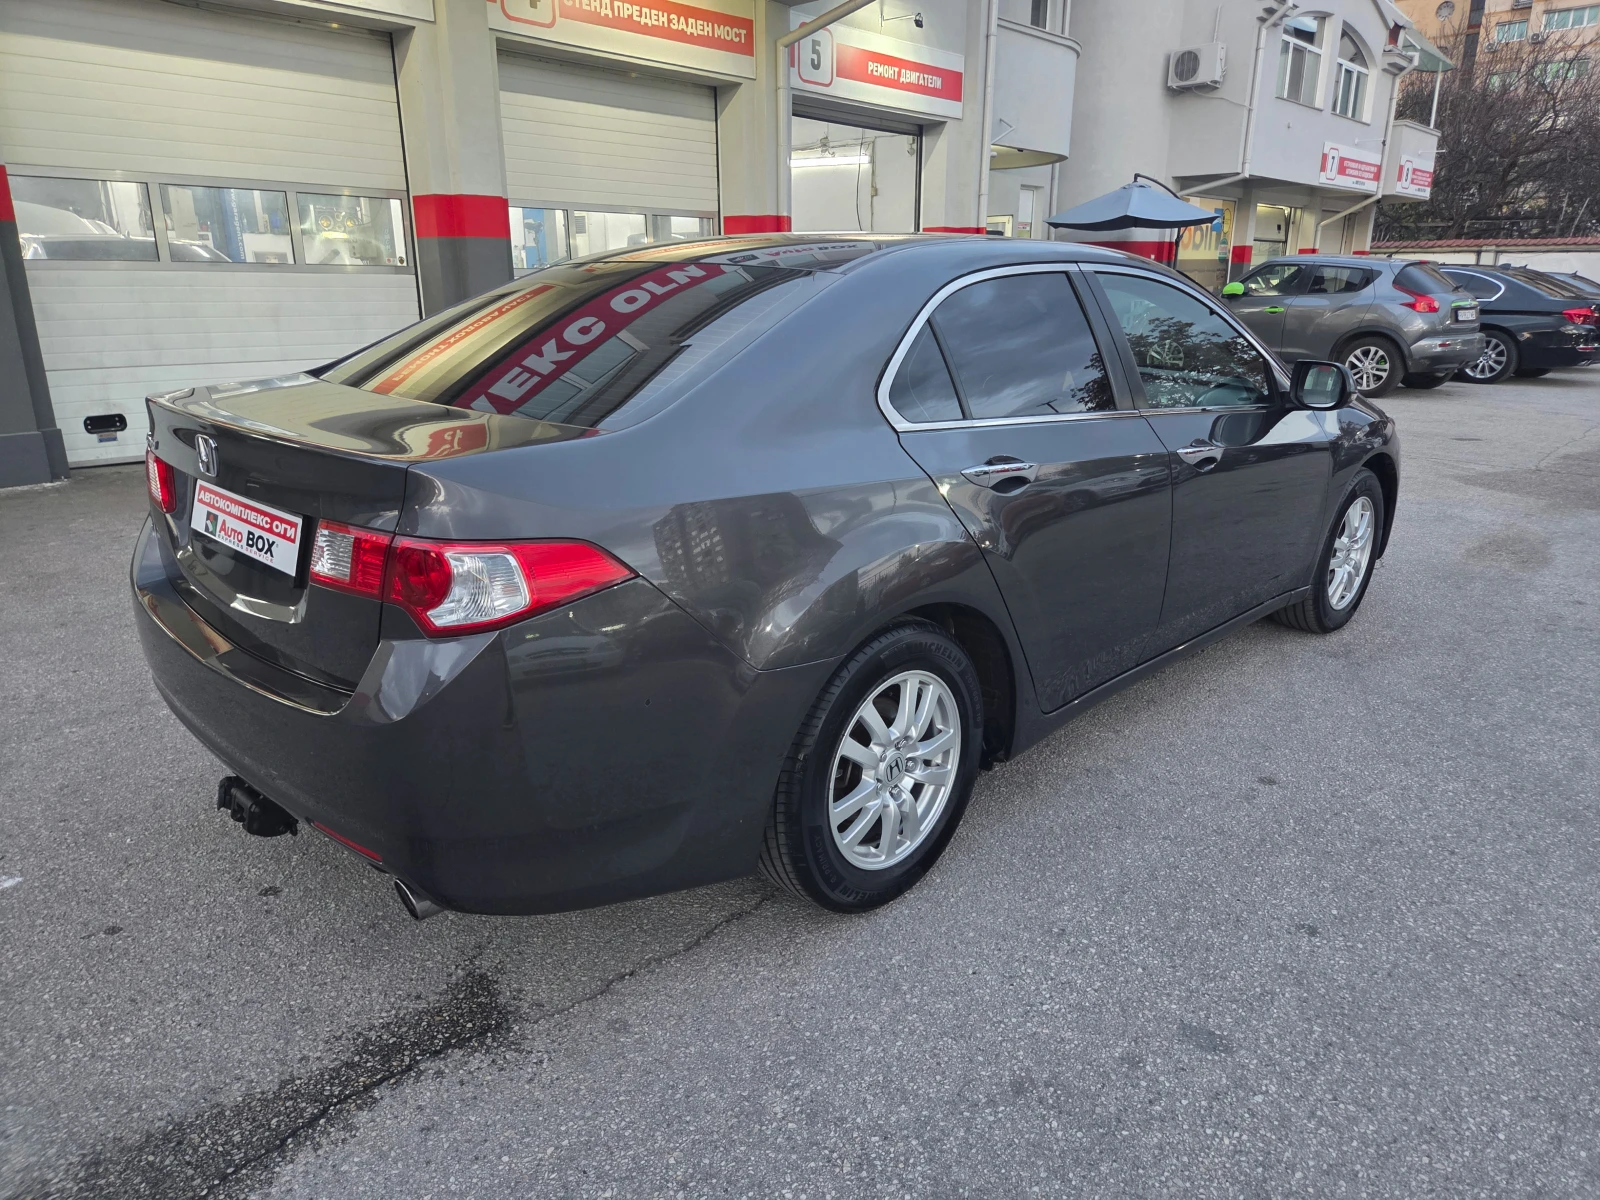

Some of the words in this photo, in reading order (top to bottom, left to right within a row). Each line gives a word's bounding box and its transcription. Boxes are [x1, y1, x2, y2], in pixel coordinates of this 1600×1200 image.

[613, 1, 667, 28] ПРЕДЕН
[670, 14, 711, 37] ЗАДЕН
[714, 24, 746, 44] МОСТ
[810, 39, 821, 71] 5
[867, 61, 898, 81] РЕМОНТ
[900, 69, 942, 90] ДВИГАТЕЛИ
[1329, 156, 1336, 173] 7
[199, 490, 271, 529] АВТОКОМПЛЕКС
[272, 520, 296, 540] ОГИ
[245, 547, 274, 563] SERVICE
[246, 529, 276, 558] BOX
[912, 641, 965, 669] MICHELIN
